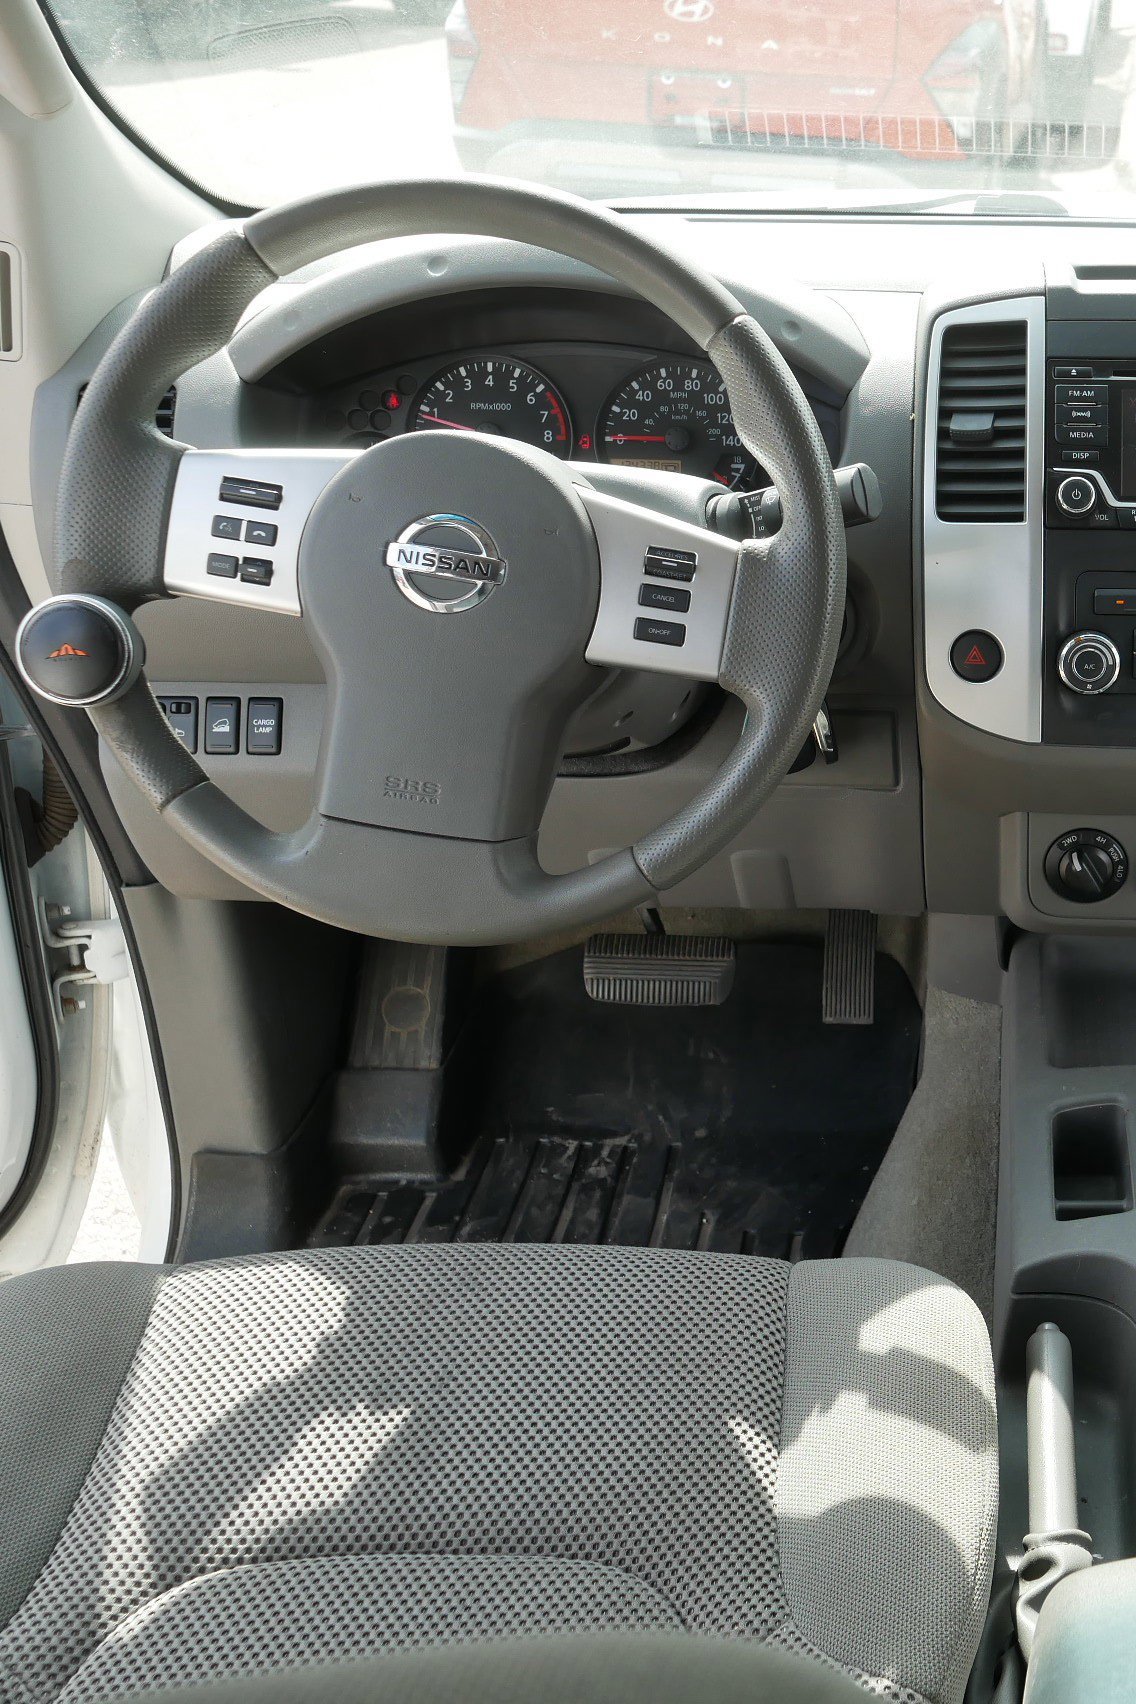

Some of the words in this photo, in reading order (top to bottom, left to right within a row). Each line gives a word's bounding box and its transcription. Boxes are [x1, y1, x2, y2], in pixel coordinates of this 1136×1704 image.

[464, 379, 472, 391] 3
[485, 375, 494, 387] 4
[509, 380, 518, 391] 5
[657, 379, 673, 390] 60
[684, 379, 701, 391] 80
[445, 390, 453, 402] 2
[526, 392, 536, 404] 6
[635, 390, 652, 402] 40
[670, 391, 688, 399] MPH
[703, 393, 724, 405] 100
[470, 402, 512, 411] RPMx1000
[433, 408, 438, 418] 1
[540, 411, 549, 423] 7
[622, 409, 638, 420] 20
[544, 430, 552, 442] 8
[721, 435, 742, 447] 140
[734, 455, 742, 463] 18
[211, 561, 231, 569] MODE
[397, 548, 492, 577] NISSAN
[652, 593, 675, 603] CANCEL
[385, 775, 441, 794] SRS
[1061, 834, 1078, 847] 2WD
[1095, 835, 1107, 845] 4H
[1108, 847, 1120, 862] PUSH
[1116, 864, 1124, 878] 4LO
